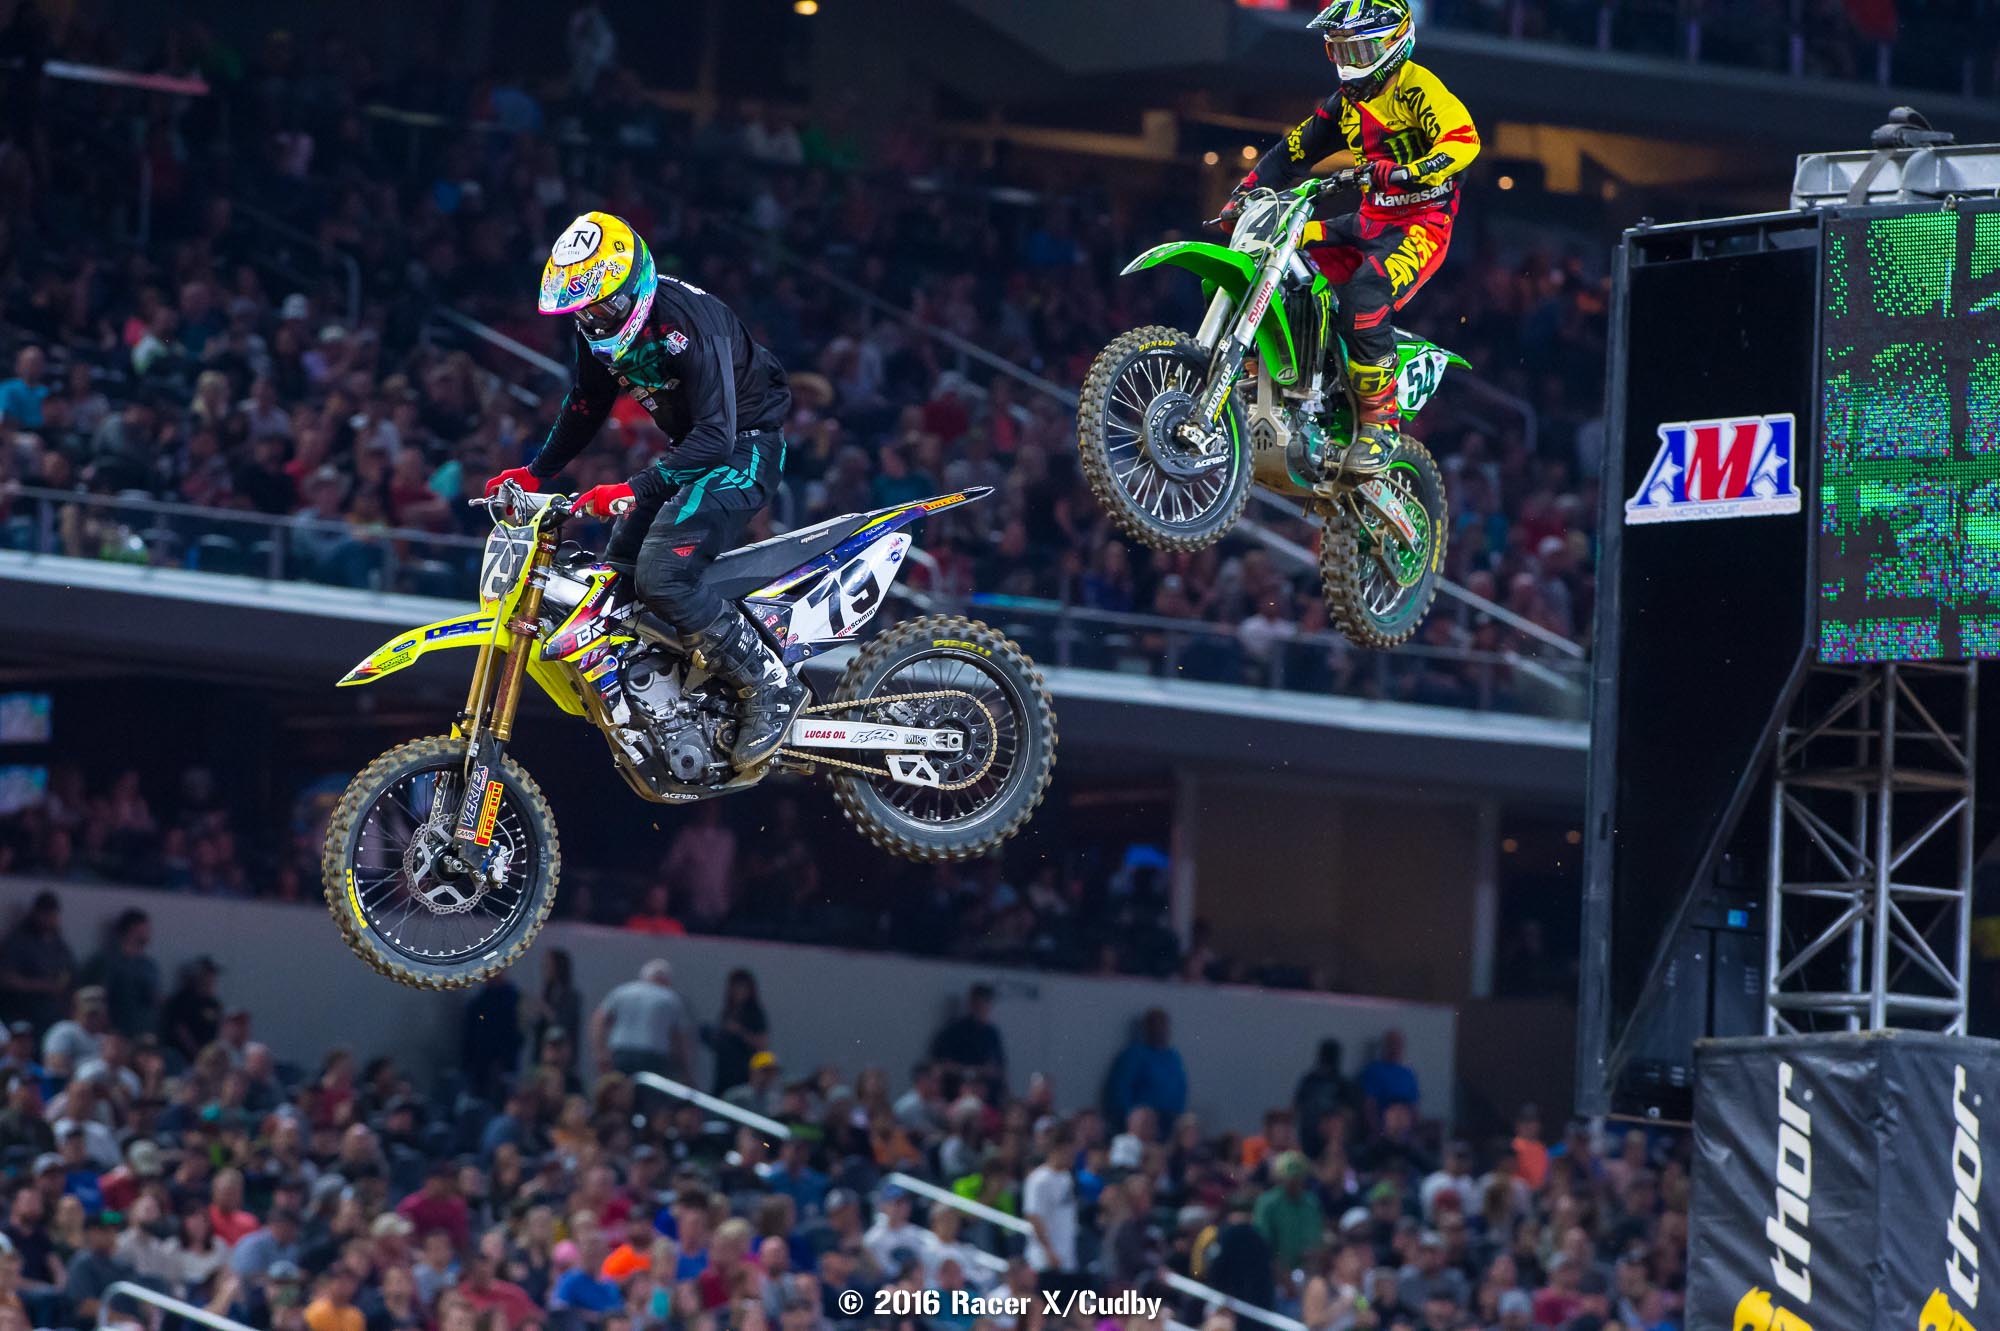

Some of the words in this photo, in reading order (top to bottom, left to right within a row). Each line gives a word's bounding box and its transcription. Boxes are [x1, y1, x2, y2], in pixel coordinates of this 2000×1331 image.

[1374, 177, 1453, 207] Kawasaki
[1138, 340, 1177, 352] DUNLOP
[1204, 363, 1232, 420] DUNLOP
[1406, 357, 1435, 408] 54
[1630, 416, 1797, 509] AMA
[481, 541, 529, 595] 79
[806, 558, 880, 636] 79
[425, 618, 495, 641] DSC
[932, 640, 992, 657] PIRELLI
[804, 730, 832, 739] LUCAS
[833, 730, 847, 739] OIL
[461, 760, 487, 828] VERTEX
[475, 781, 503, 846] PIRELLI
[1766, 1061, 1812, 1304] thor
[1945, 1064, 1983, 1309] thor
